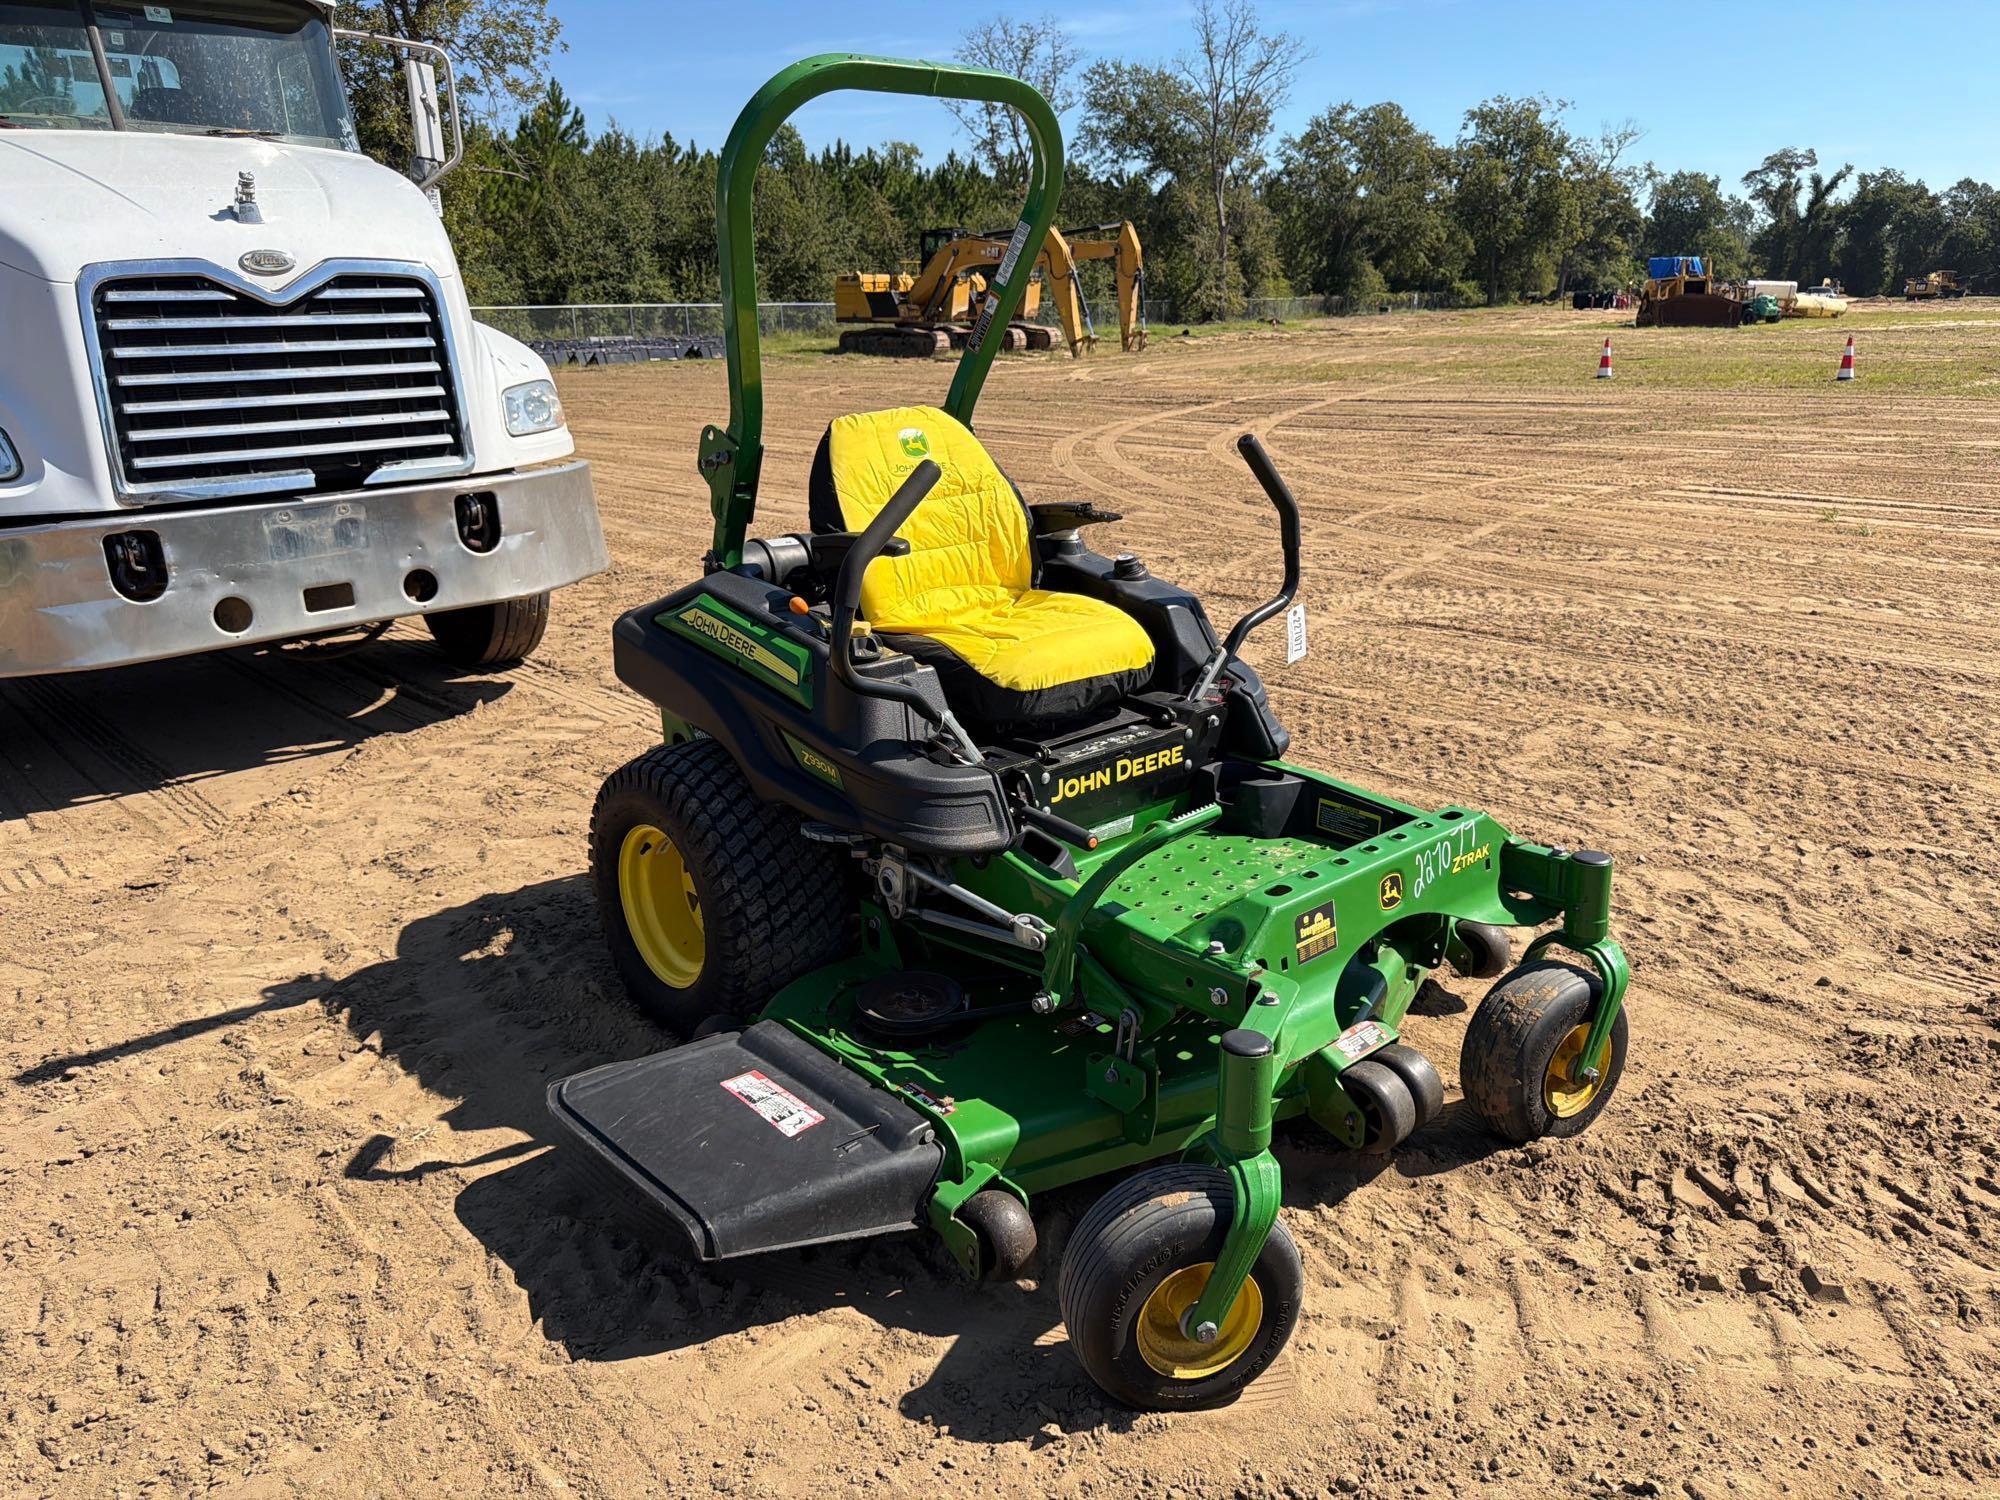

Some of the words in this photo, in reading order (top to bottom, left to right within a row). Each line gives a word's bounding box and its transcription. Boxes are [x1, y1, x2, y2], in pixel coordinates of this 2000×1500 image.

[986, 246, 1000, 258] CAT
[688, 611, 719, 639] JOHN
[719, 626, 757, 659] DEERE
[1292, 616, 1303, 652] 227077
[801, 750, 838, 778] Z930M
[1051, 767, 1111, 804] JOHN
[1116, 745, 1184, 782] DEERE
[1452, 843, 1490, 874] ZTRAK
